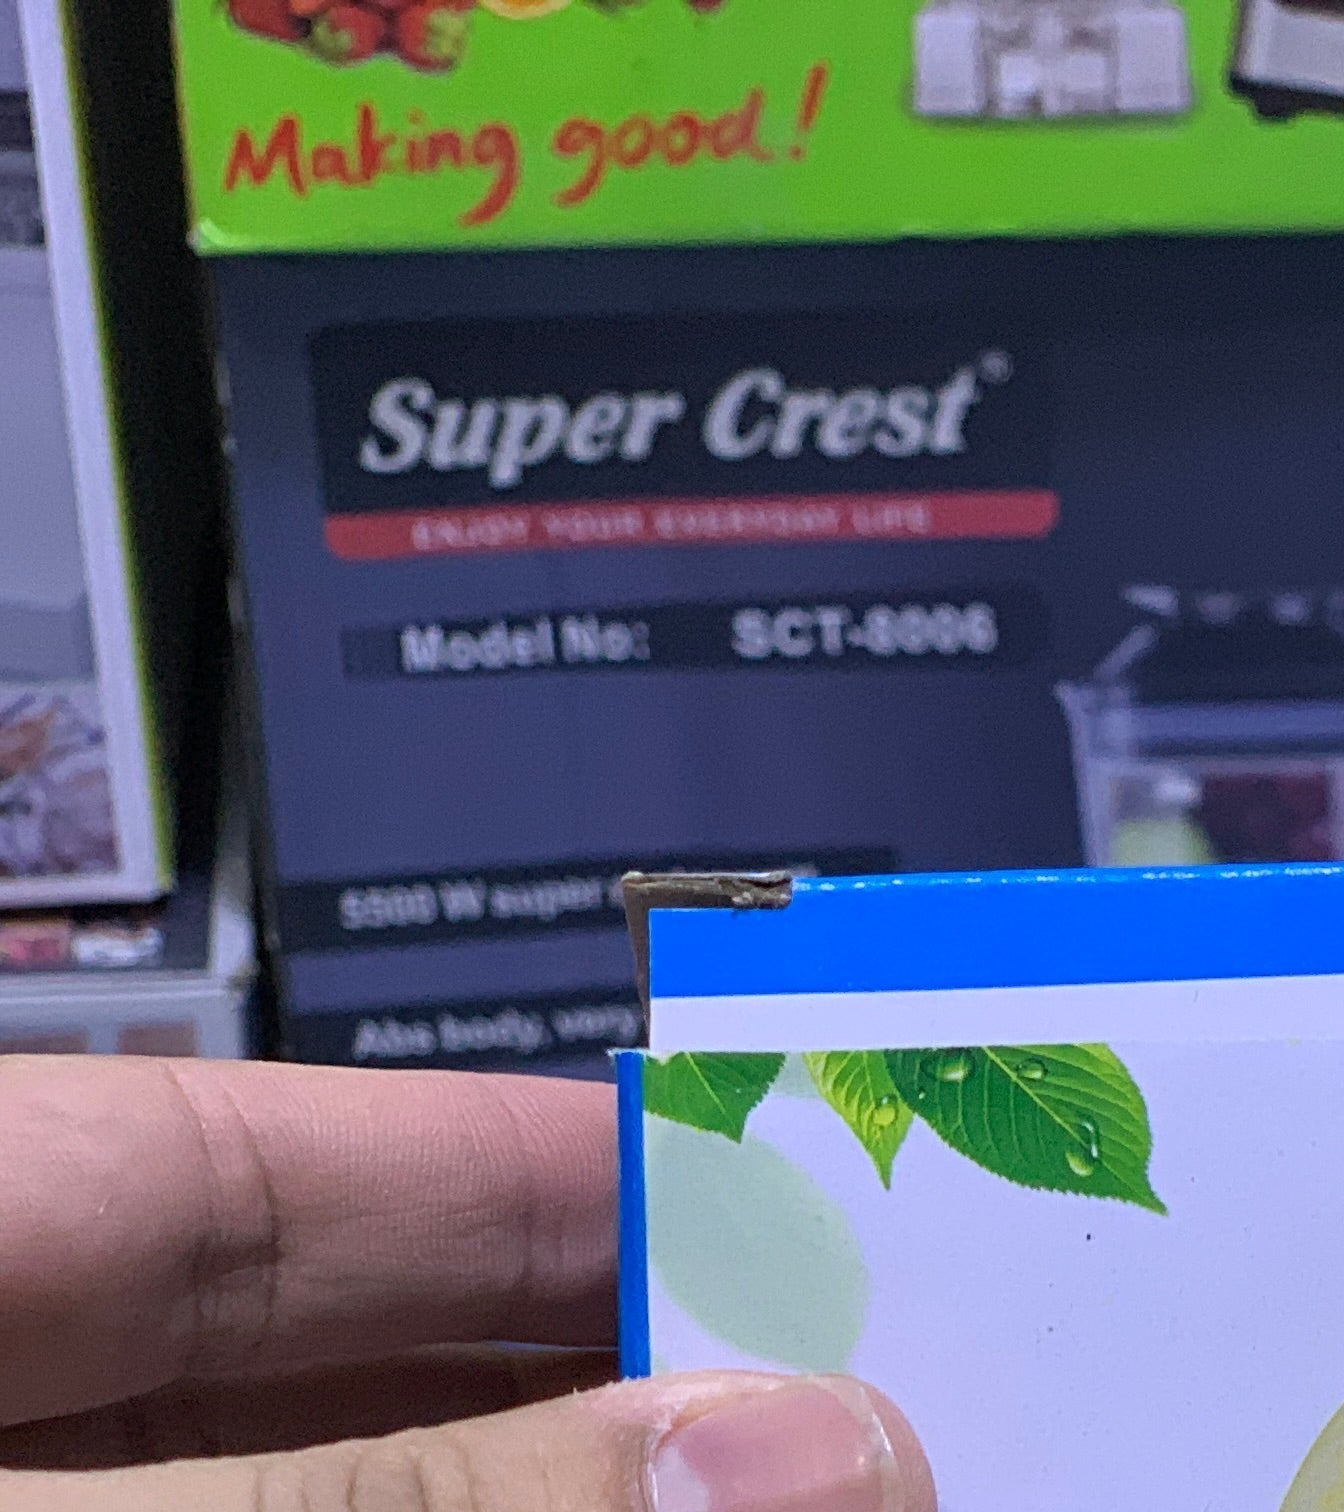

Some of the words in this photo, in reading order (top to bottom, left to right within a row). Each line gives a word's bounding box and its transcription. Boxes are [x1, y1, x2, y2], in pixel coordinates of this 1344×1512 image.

[224, 100, 519, 228] Making
[551, 62, 830, 207] good!
[359, 376, 685, 488] Super
[703, 365, 980, 461] Crest
[410, 516, 530, 552] ENJOY
[542, 510, 643, 541] YOUR
[852, 499, 930, 535] LIFE
[401, 618, 555, 673] Model
[561, 616, 650, 662] No:
